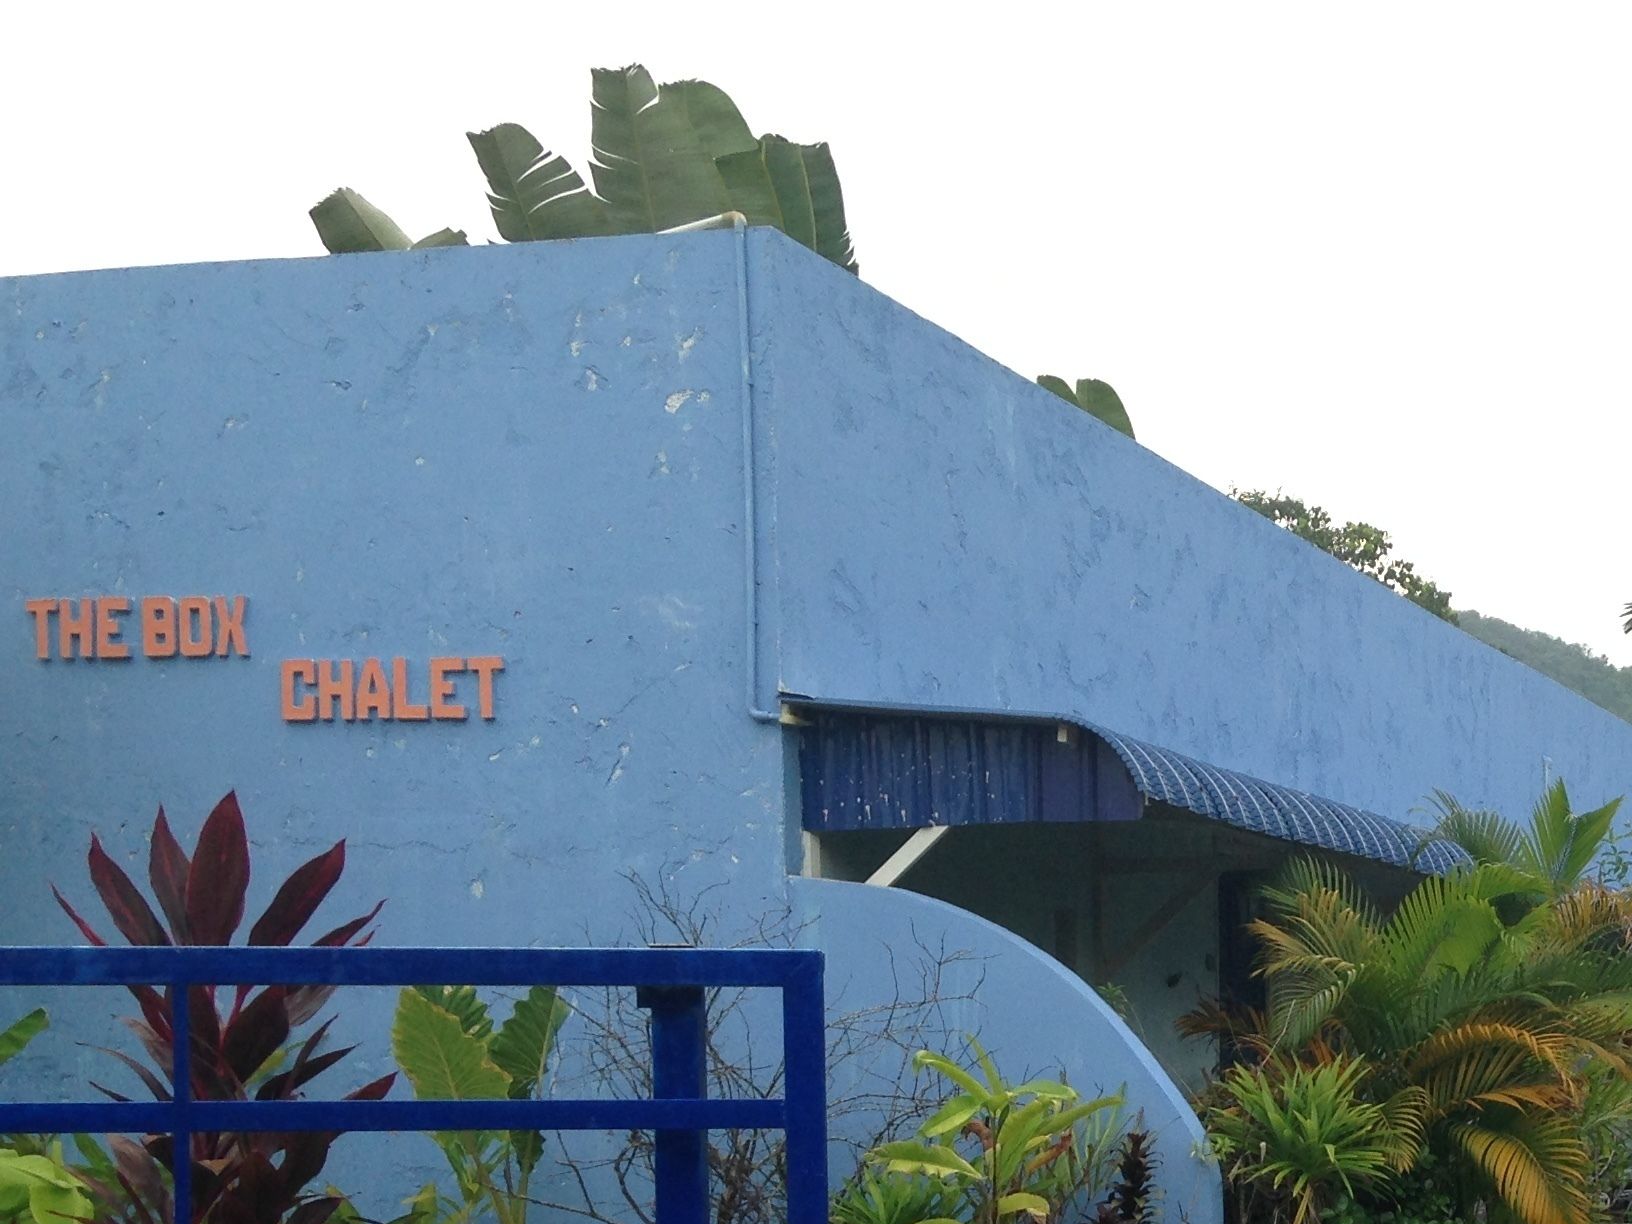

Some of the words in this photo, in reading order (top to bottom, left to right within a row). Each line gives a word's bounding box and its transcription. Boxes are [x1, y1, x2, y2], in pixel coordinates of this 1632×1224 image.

[26, 596, 131, 660] THE
[142, 595, 250, 657] BOX
[280, 656, 504, 722] CHALET
